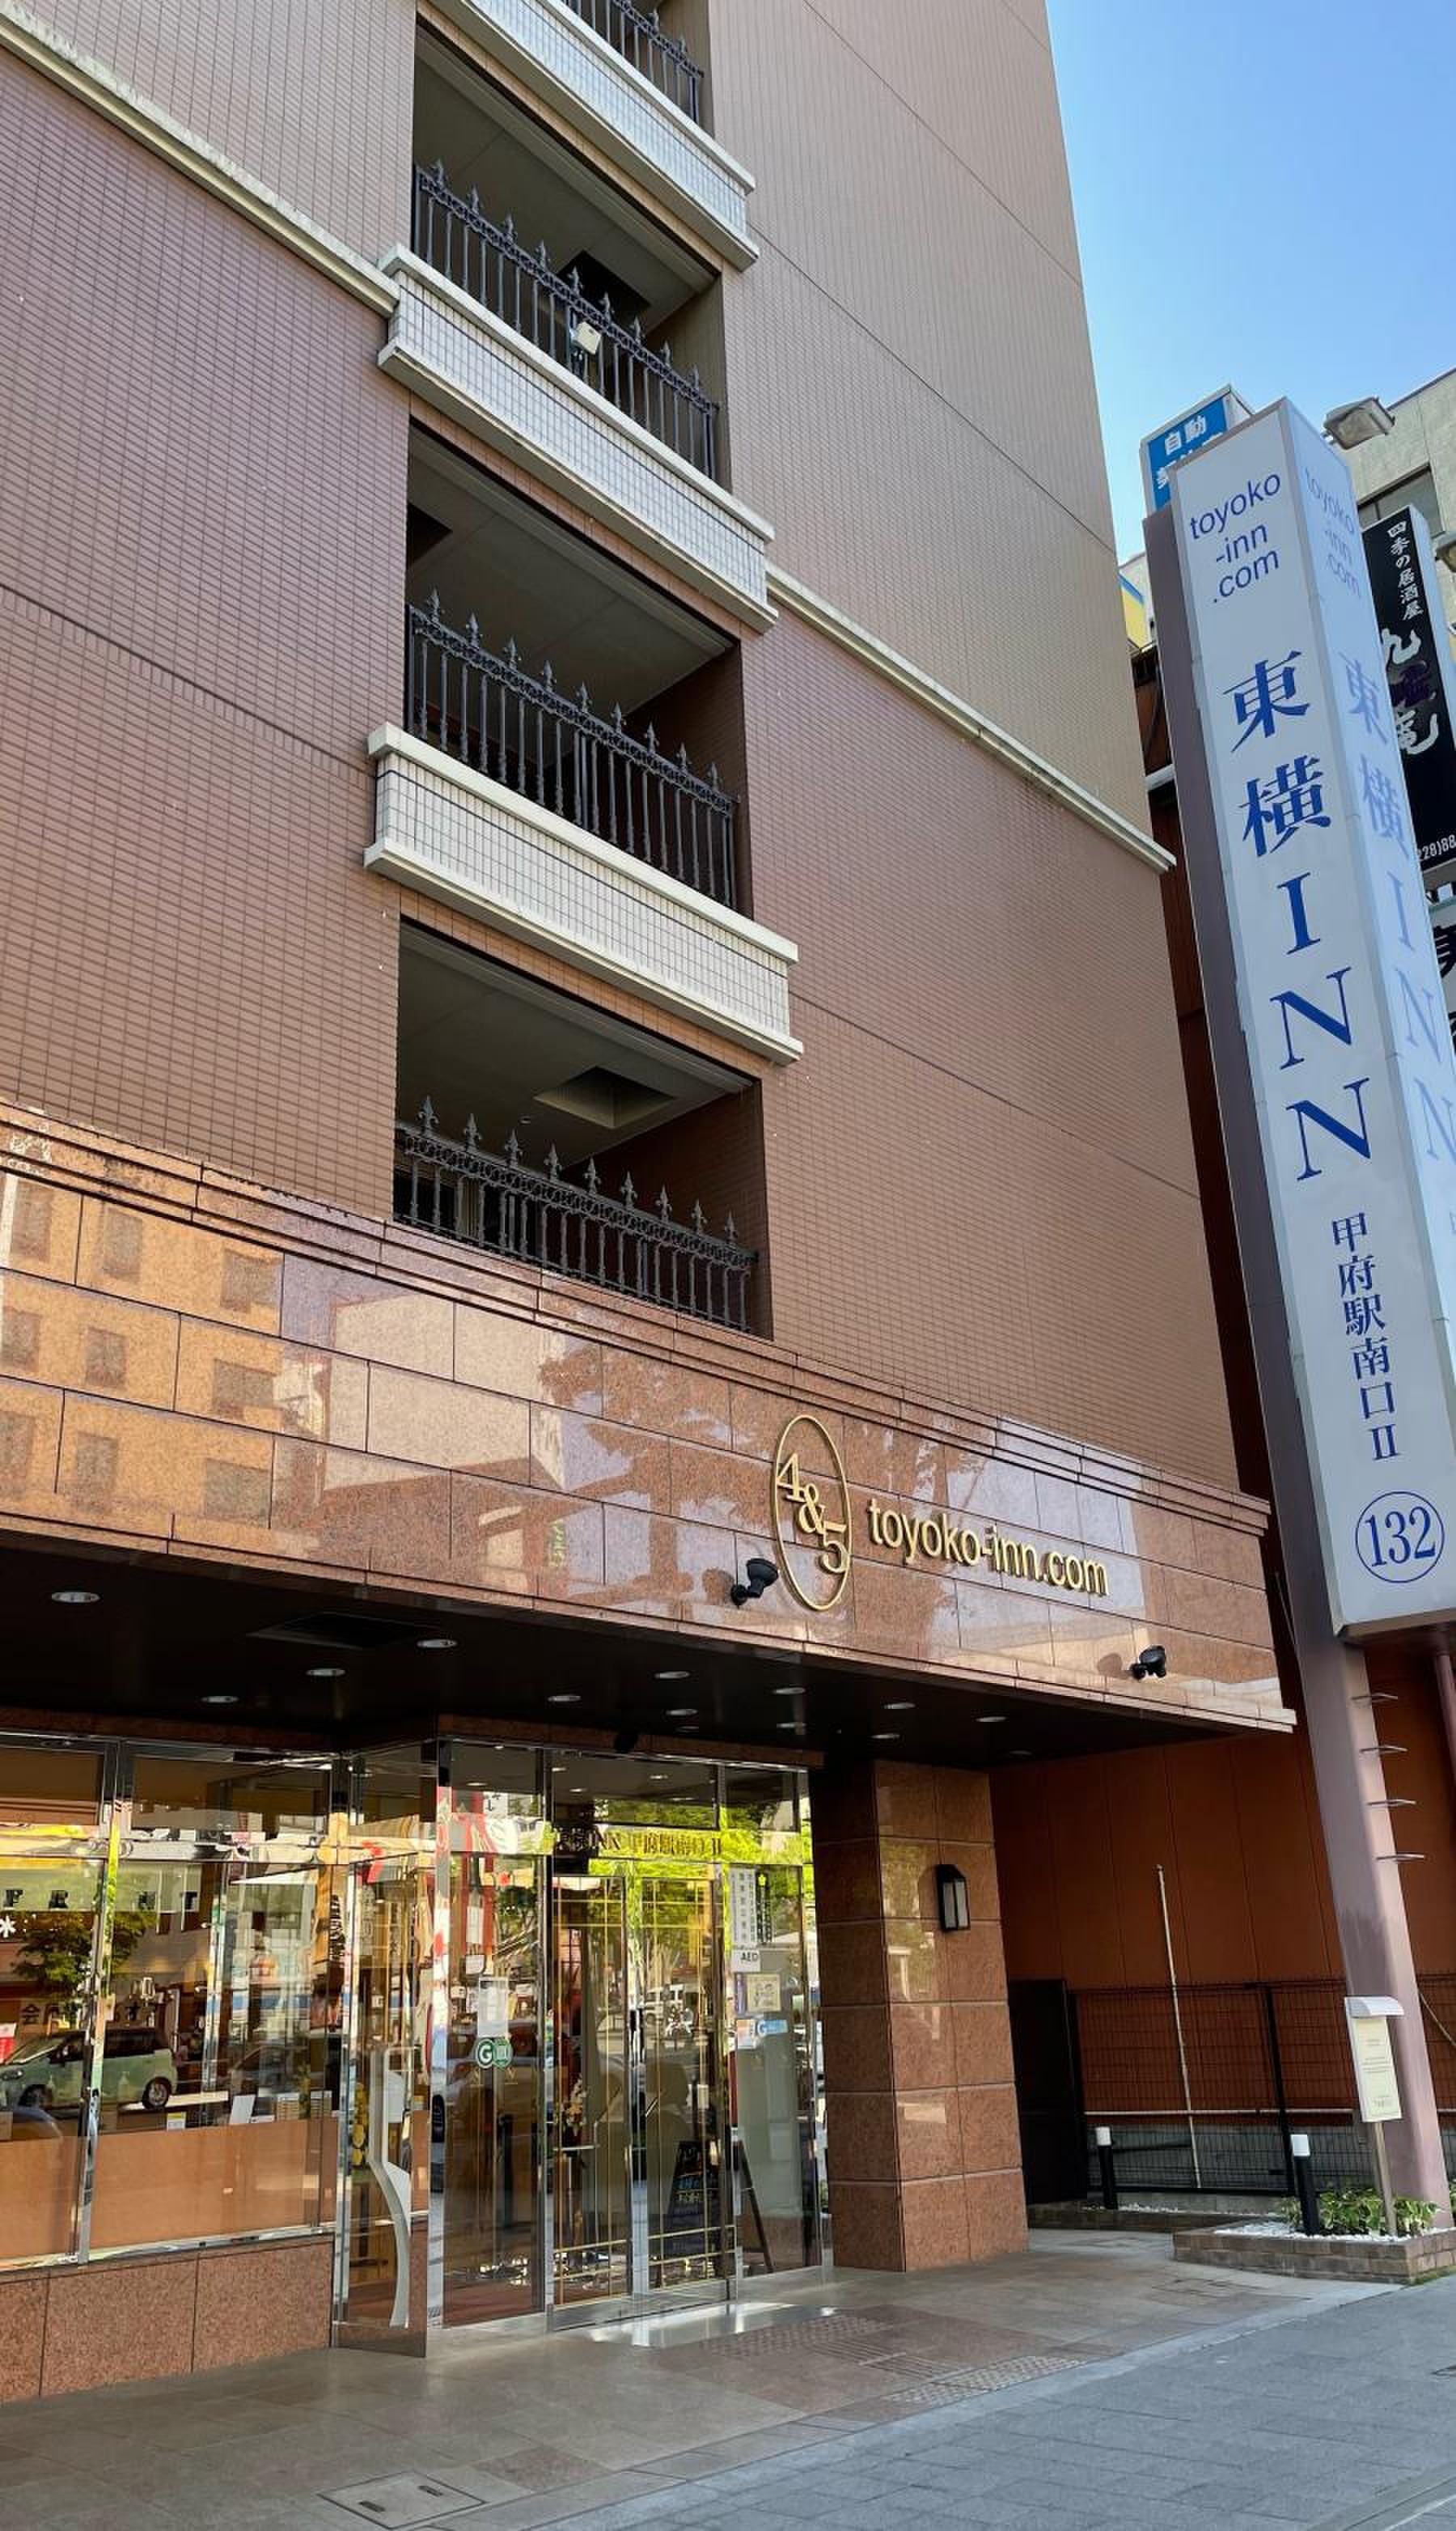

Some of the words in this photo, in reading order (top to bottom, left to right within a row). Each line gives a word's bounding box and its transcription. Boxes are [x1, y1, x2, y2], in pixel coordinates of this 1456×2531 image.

[1190, 474, 1280, 540] toyoko
[1216, 524, 1268, 563] -inn
[1386, 520, 1424, 621] 四季の居酒屋
[1213, 550, 1280, 604] .com
[1222, 649, 1371, 1181] 東横INN
[867, 1498, 1109, 1596] toyoko-inn.com
[1364, 1506, 1436, 1567] 132
